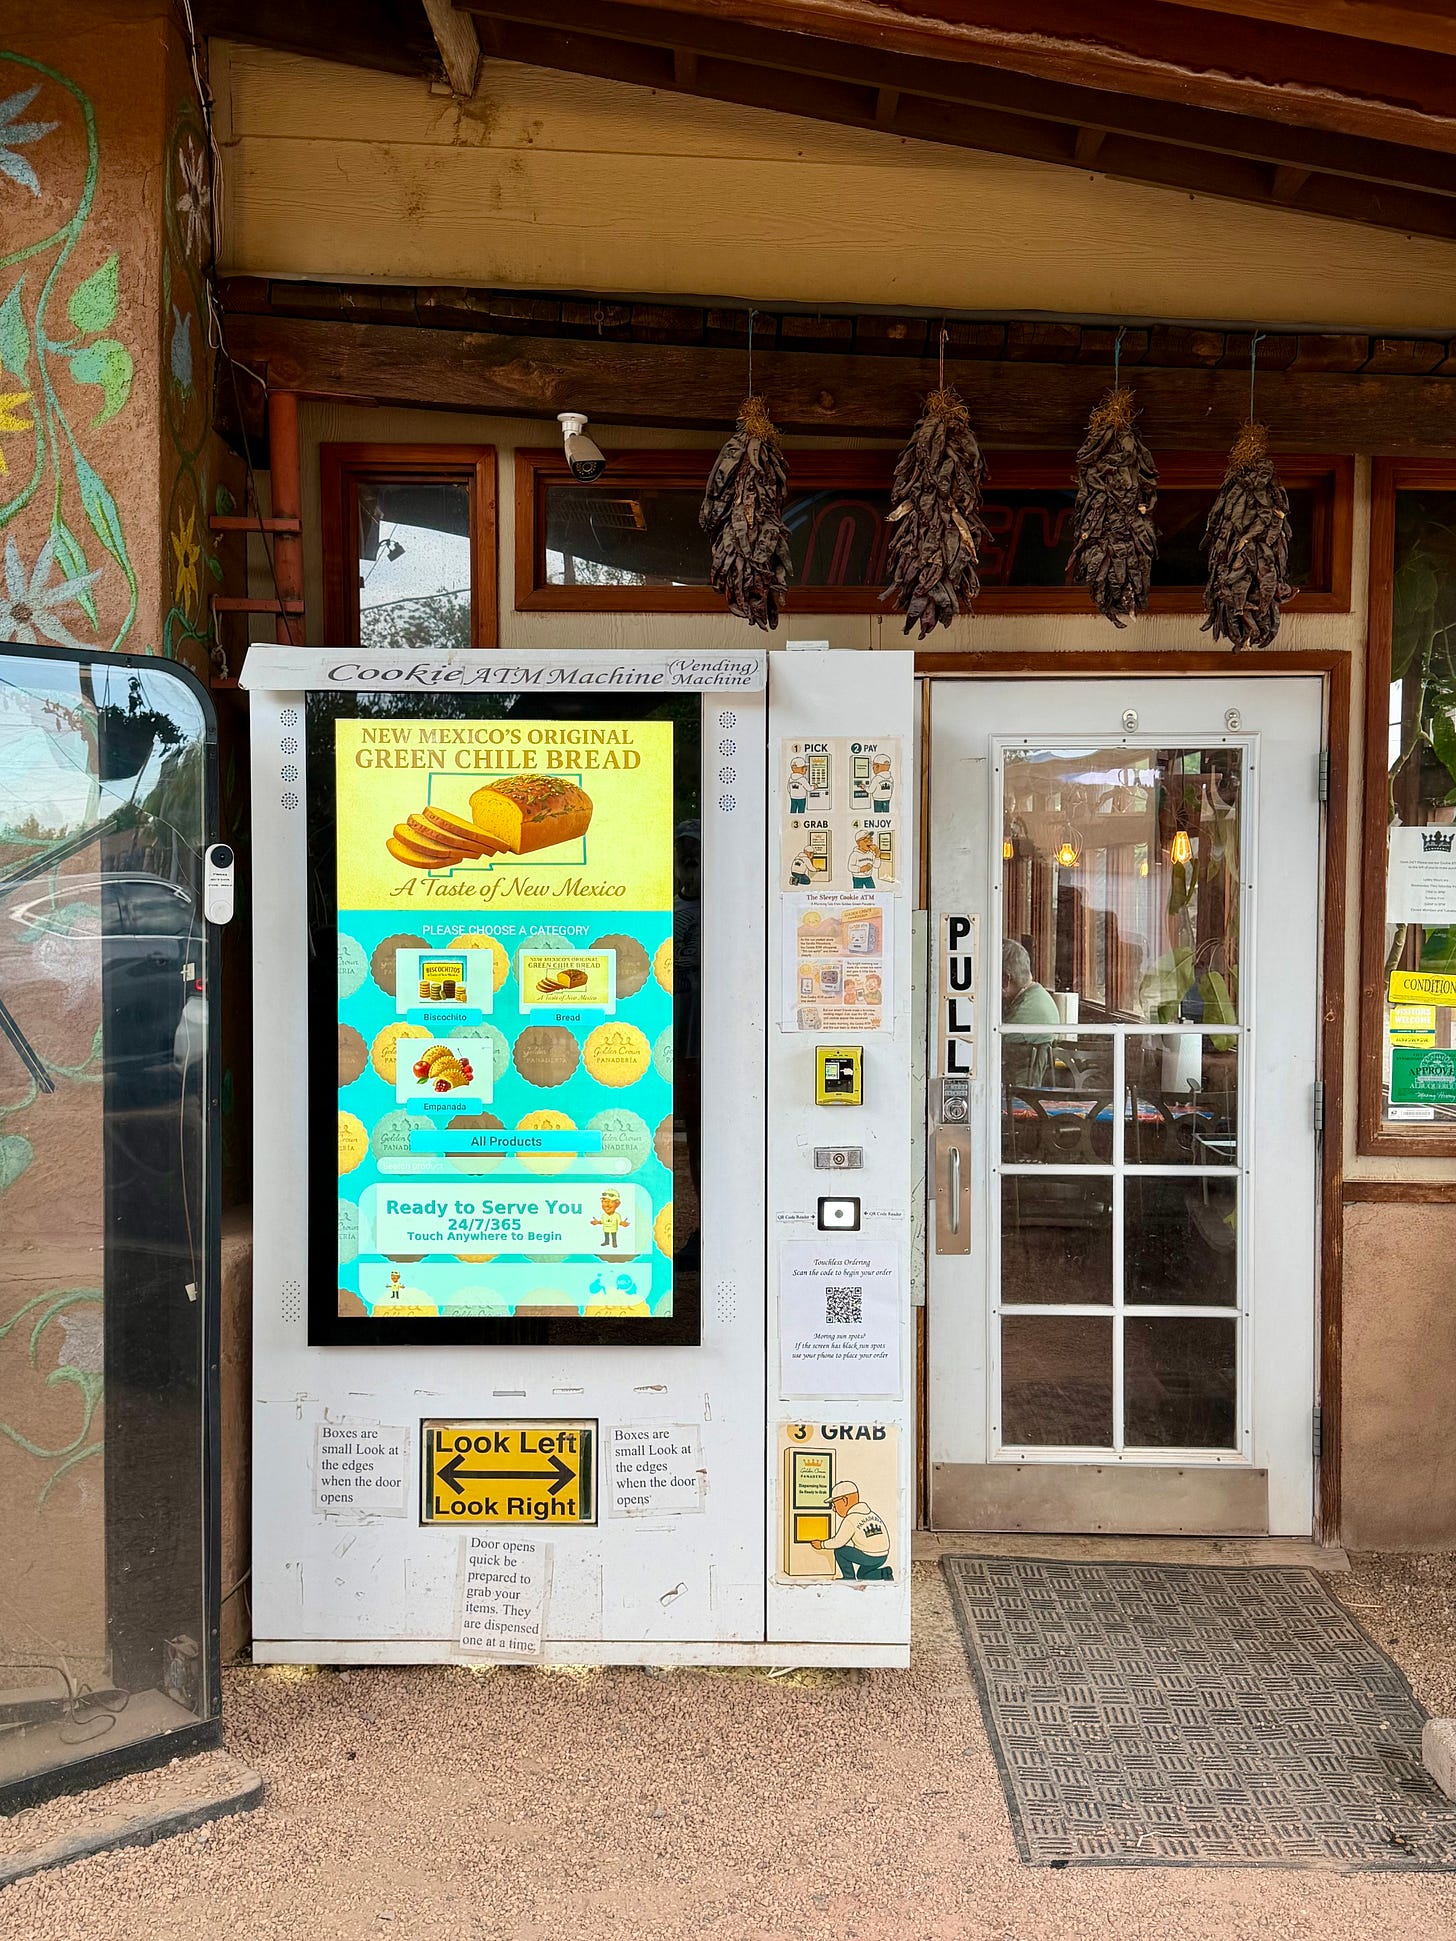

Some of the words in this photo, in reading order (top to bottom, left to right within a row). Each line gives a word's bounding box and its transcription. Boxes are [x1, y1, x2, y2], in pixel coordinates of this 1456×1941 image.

[328, 663, 463, 686] Cookie
[464, 667, 547, 685] ATM
[547, 666, 663, 685] Machine
[667, 658, 759, 678] (Vending)
[671, 672, 752, 686] Machine
[361, 727, 412, 744] NEW
[419, 727, 521, 744] MEXICO'S
[528, 728, 634, 745] ORIGINAL
[794, 744, 798, 752] 1
[804, 743, 828, 752] PICK
[863, 744, 878, 752] PAY
[355, 749, 445, 769] GREEN
[455, 749, 538, 769] CHILE
[547, 750, 641, 770] BREAD
[793, 821, 799, 829] 3
[803, 820, 828, 829] GRAB
[853, 820, 859, 828] 4
[863, 819, 892, 828] ENJOY
[389, 877, 418, 897] A
[420, 877, 475, 897] Taste
[479, 877, 505, 903] of
[501, 877, 550, 897] New
[553, 877, 627, 897] Mexico
[422, 924, 466, 936] PLEASE
[468, 924, 516, 936] CHOOSE
[518, 925, 528, 936] A
[529, 925, 590, 936] CATEGORY
[947, 916, 972, 1074] PULL
[423, 1013, 467, 1021] Biscochito
[555, 1013, 581, 1021] Bread
[423, 1102, 467, 1112] Empanada
[470, 1135, 486, 1147] All
[489, 1135, 543, 1147] Products
[386, 1199, 450, 1218] Ready
[455, 1200, 475, 1215] to
[482, 1200, 540, 1215] Serve
[545, 1200, 583, 1215] You
[448, 1218, 522, 1232] 24/7/365
[407, 1231, 444, 1242] Touch
[447, 1231, 508, 1244] Anywhere
[511, 1232, 524, 1242] to
[528, 1231, 563, 1244] Begin
[813, 1258, 843, 1266] Touchless
[843, 1258, 871, 1267] Ordering
[809, 1268, 819, 1276] the
[820, 1268, 833, 1276] code
[843, 1268, 859, 1277] begin
[860, 1270, 875, 1278] your
[875, 1268, 892, 1276] order
[794, 1341, 802, 1350] If
[802, 1341, 811, 1349] the
[831, 1341, 841, 1349] has
[842, 1341, 859, 1350] black
[817, 1352, 834, 1360] phone
[843, 1352, 858, 1360] place
[322, 1427, 358, 1438] Boxes
[360, 1430, 378, 1439] are
[615, 1429, 650, 1441] Boxes
[652, 1430, 670, 1439] are
[793, 1424, 807, 1440] 3
[821, 1424, 887, 1441] GRAB
[436, 1430, 510, 1454] Look
[520, 1431, 577, 1454] Left
[321, 1443, 352, 1454] small
[356, 1444, 385, 1455] Look
[388, 1446, 399, 1455] at
[615, 1445, 645, 1457] small
[649, 1443, 678, 1456] Look
[681, 1445, 692, 1454] at
[321, 1459, 339, 1470] the
[342, 1459, 374, 1473] edges
[616, 1461, 633, 1473] the
[636, 1461, 668, 1474] edges
[321, 1475, 352, 1486] when
[355, 1475, 372, 1487] the
[375, 1476, 402, 1487] door
[616, 1477, 647, 1489] when
[650, 1476, 667, 1488] the
[670, 1475, 697, 1487] door
[320, 1493, 354, 1505] opens
[617, 1494, 650, 1508] opens
[435, 1495, 499, 1515] Look
[507, 1497, 576, 1521] Right
[471, 1537, 501, 1550] Door
[502, 1541, 536, 1553] opens
[469, 1553, 501, 1567] quick
[504, 1555, 517, 1567] be
[467, 1571, 517, 1584] prepared
[520, 1574, 531, 1584] to
[466, 1586, 492, 1599] grab
[494, 1590, 521, 1601] your
[465, 1601, 498, 1614] items.
[502, 1604, 532, 1620] They
[463, 1619, 481, 1629] are
[484, 1619, 540, 1635] dispensed
[462, 1636, 483, 1646] one
[486, 1637, 496, 1647] at
[499, 1640, 506, 1648] a
